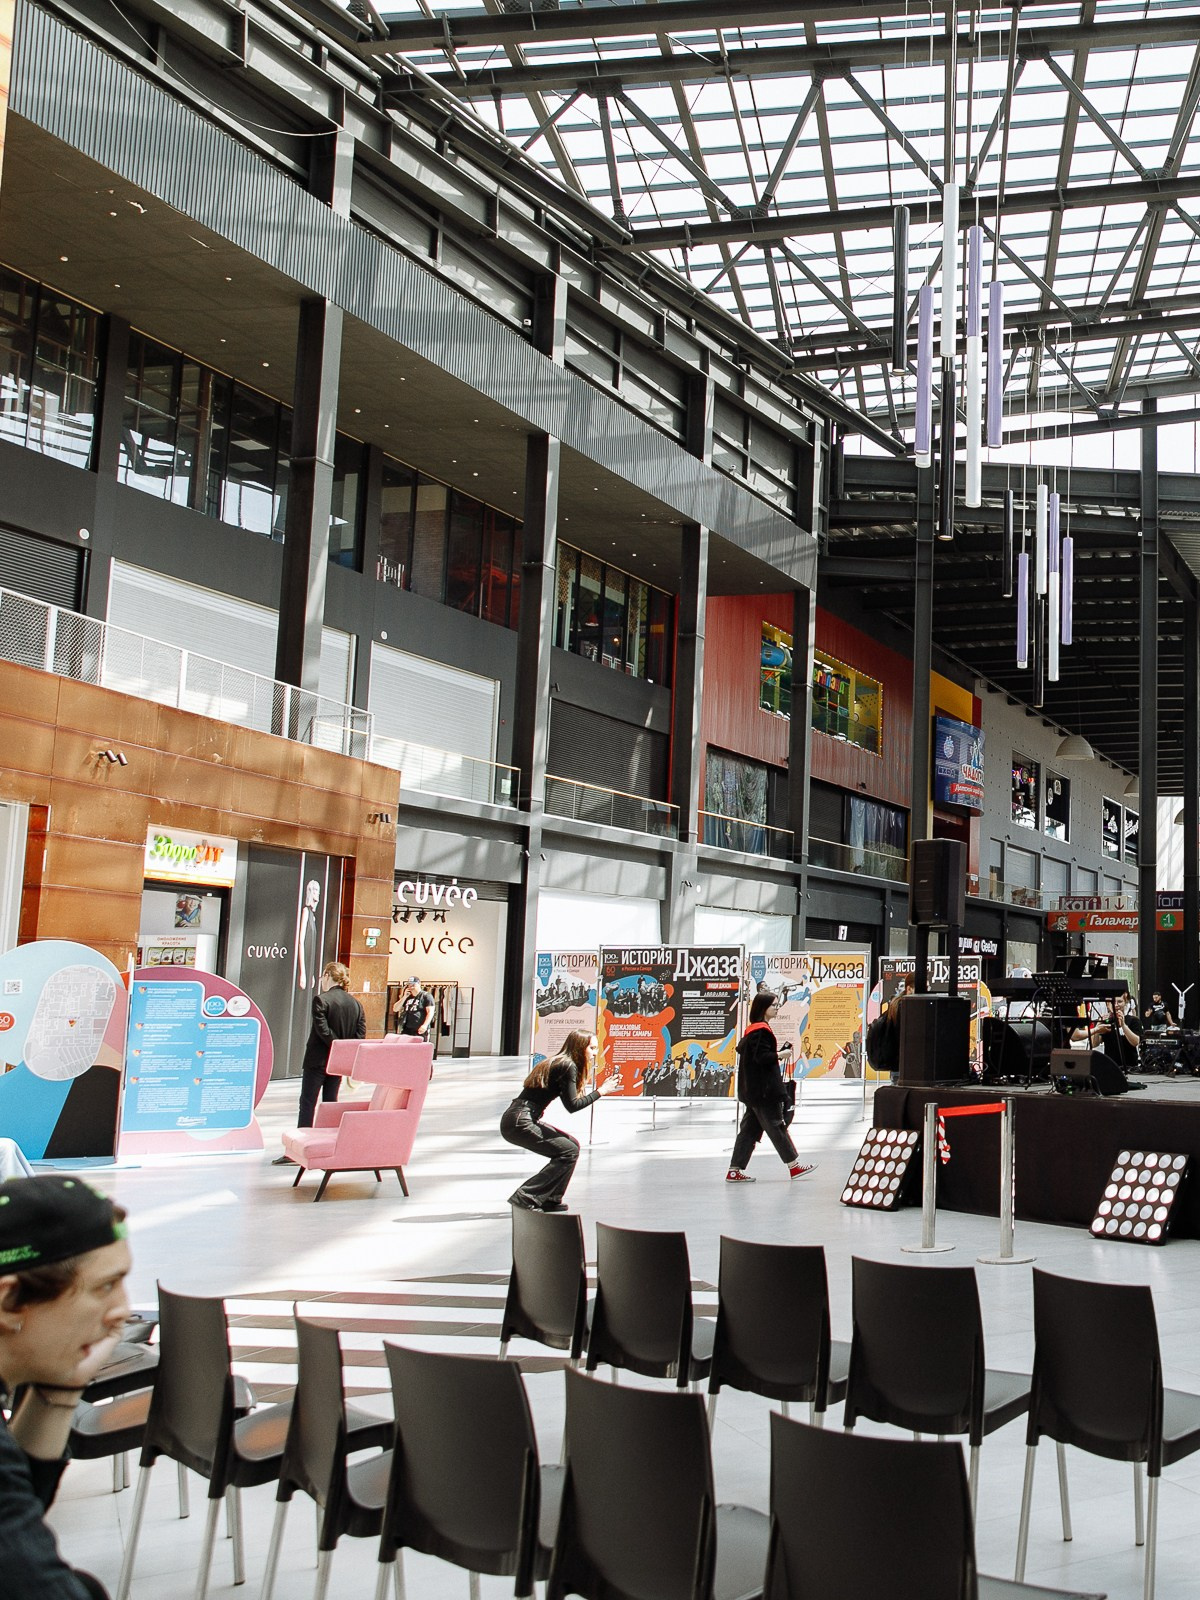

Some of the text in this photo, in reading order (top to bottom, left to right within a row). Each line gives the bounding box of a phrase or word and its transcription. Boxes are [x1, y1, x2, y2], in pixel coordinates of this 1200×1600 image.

[1089, 914, 1139, 929] Галамар
[554, 954, 598, 967] ИСТОРИЯ
[621, 950, 672, 965] ИСТОРИЯ
[673, 949, 741, 981] Джаза
[767, 957, 808, 969] ИСТОРИЯ
[809, 957, 864, 982] Джаза
